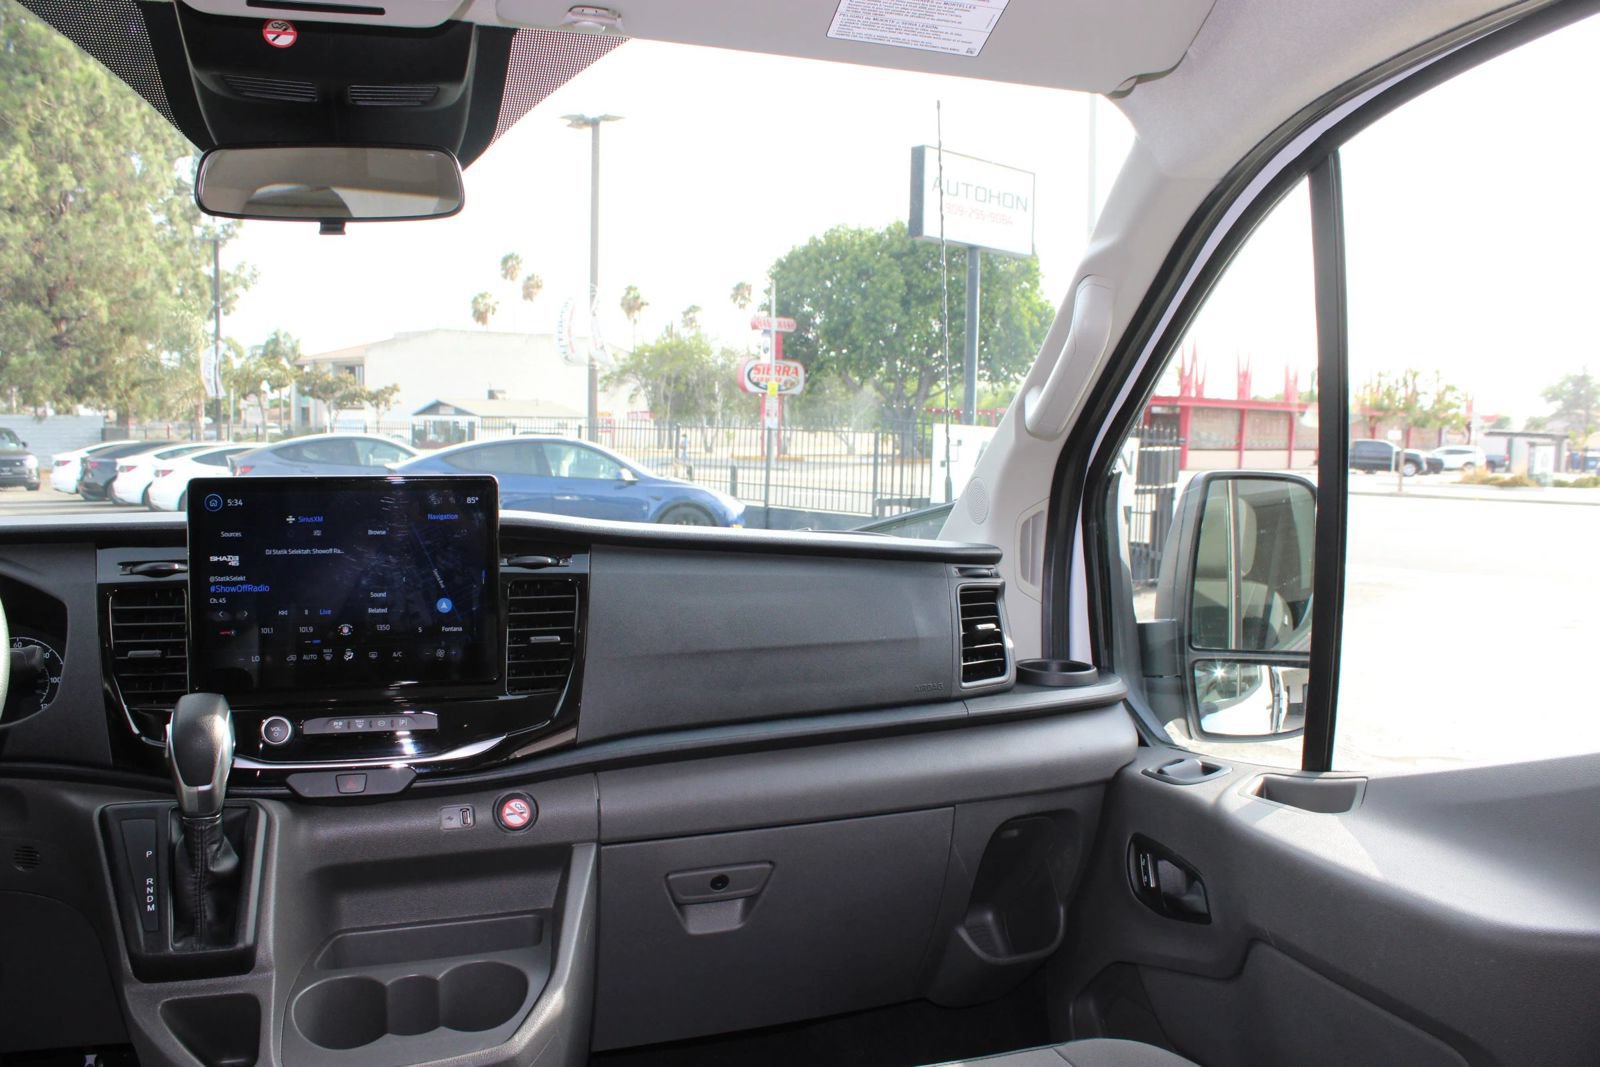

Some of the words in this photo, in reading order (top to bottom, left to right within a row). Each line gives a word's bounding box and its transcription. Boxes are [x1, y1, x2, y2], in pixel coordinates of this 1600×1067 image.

[932, 176, 1028, 212] AUTOHON
[227, 499, 243, 507] 5:34
[298, 515, 324, 523] SiriusXM
[427, 513, 459, 521] Navigation
[210, 584, 270, 593] #ShowOffRadio
[145, 850, 153, 858] P
[147, 904, 155, 912] M
